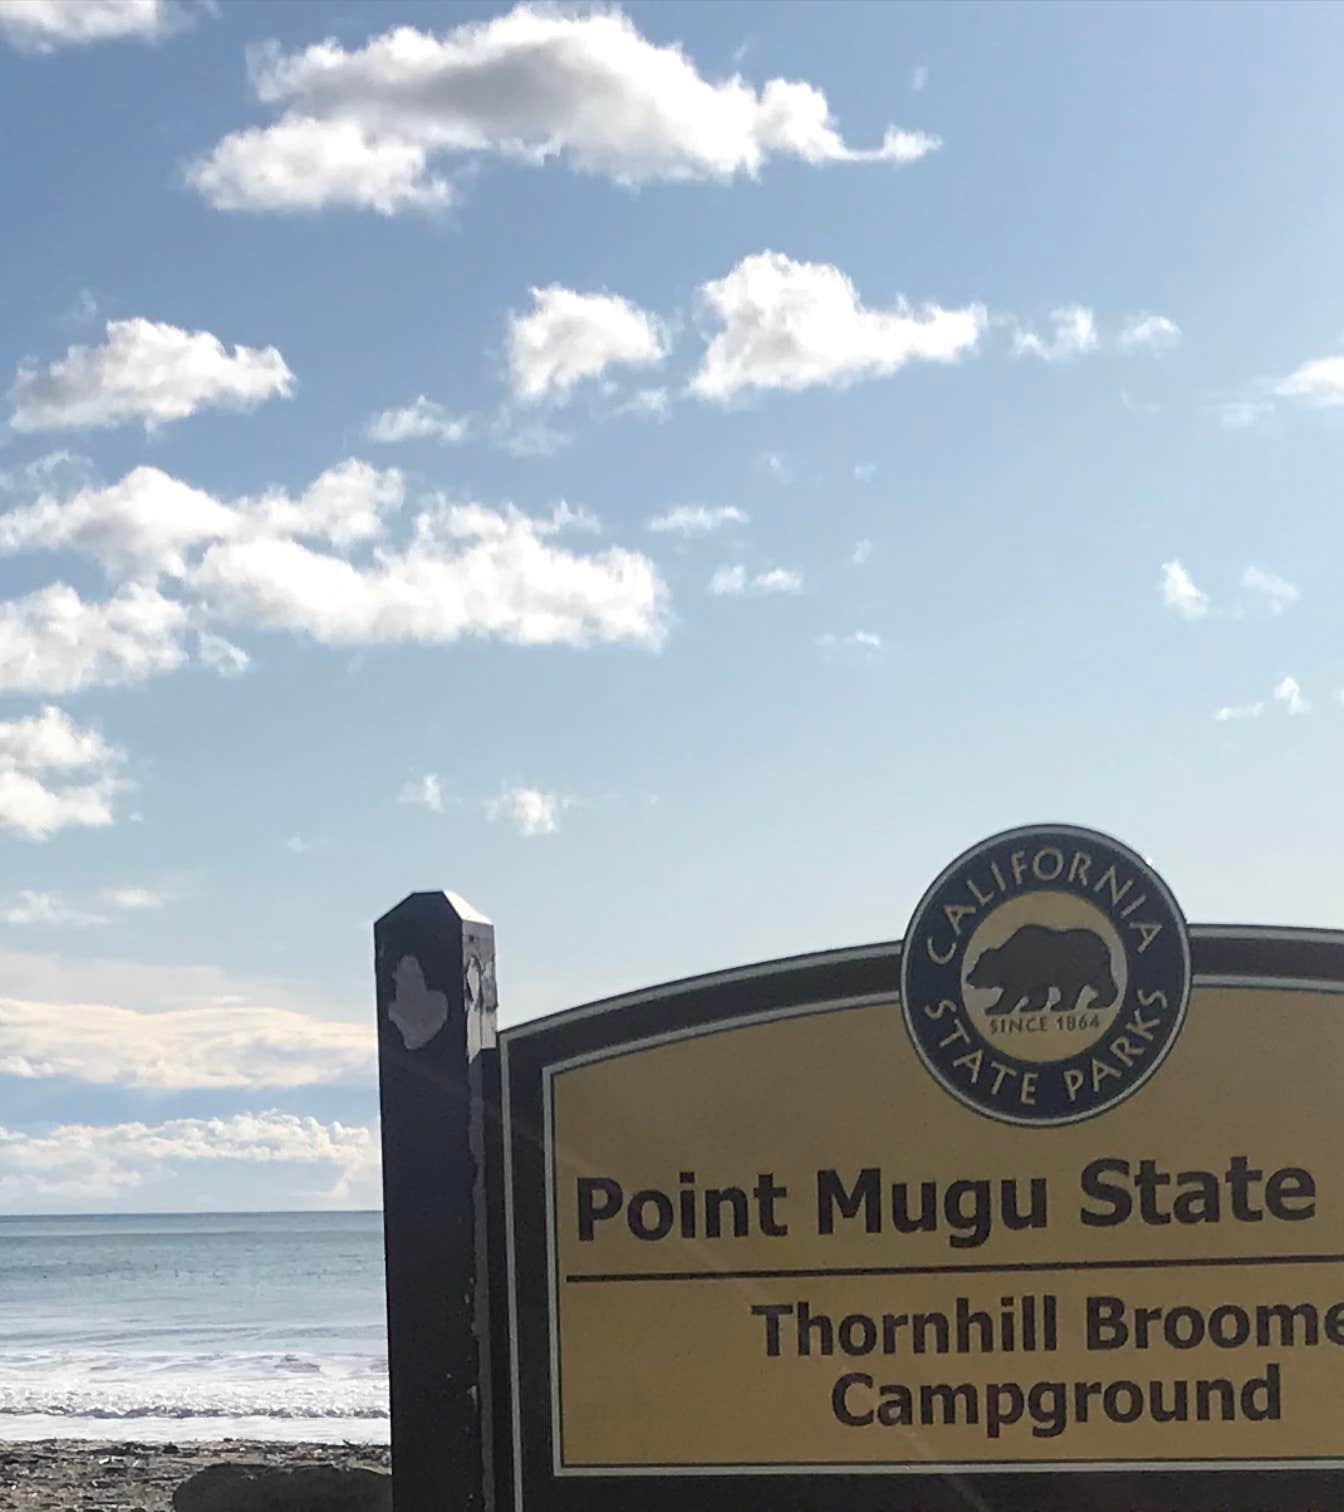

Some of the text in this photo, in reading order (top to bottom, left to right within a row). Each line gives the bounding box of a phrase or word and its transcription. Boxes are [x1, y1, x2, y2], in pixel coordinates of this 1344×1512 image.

[926, 848, 1163, 966] CALIFORNIA
[924, 987, 1168, 1105] STATE PARKS
[989, 1013, 1101, 1035] SINCE 1864
[576, 1171, 788, 1242] Point
[816, 1167, 1048, 1249] Mugu
[1079, 1154, 1317, 1228] State
[751, 1294, 1057, 1358] Thornhill
[831, 1362, 1282, 1439] Campground
